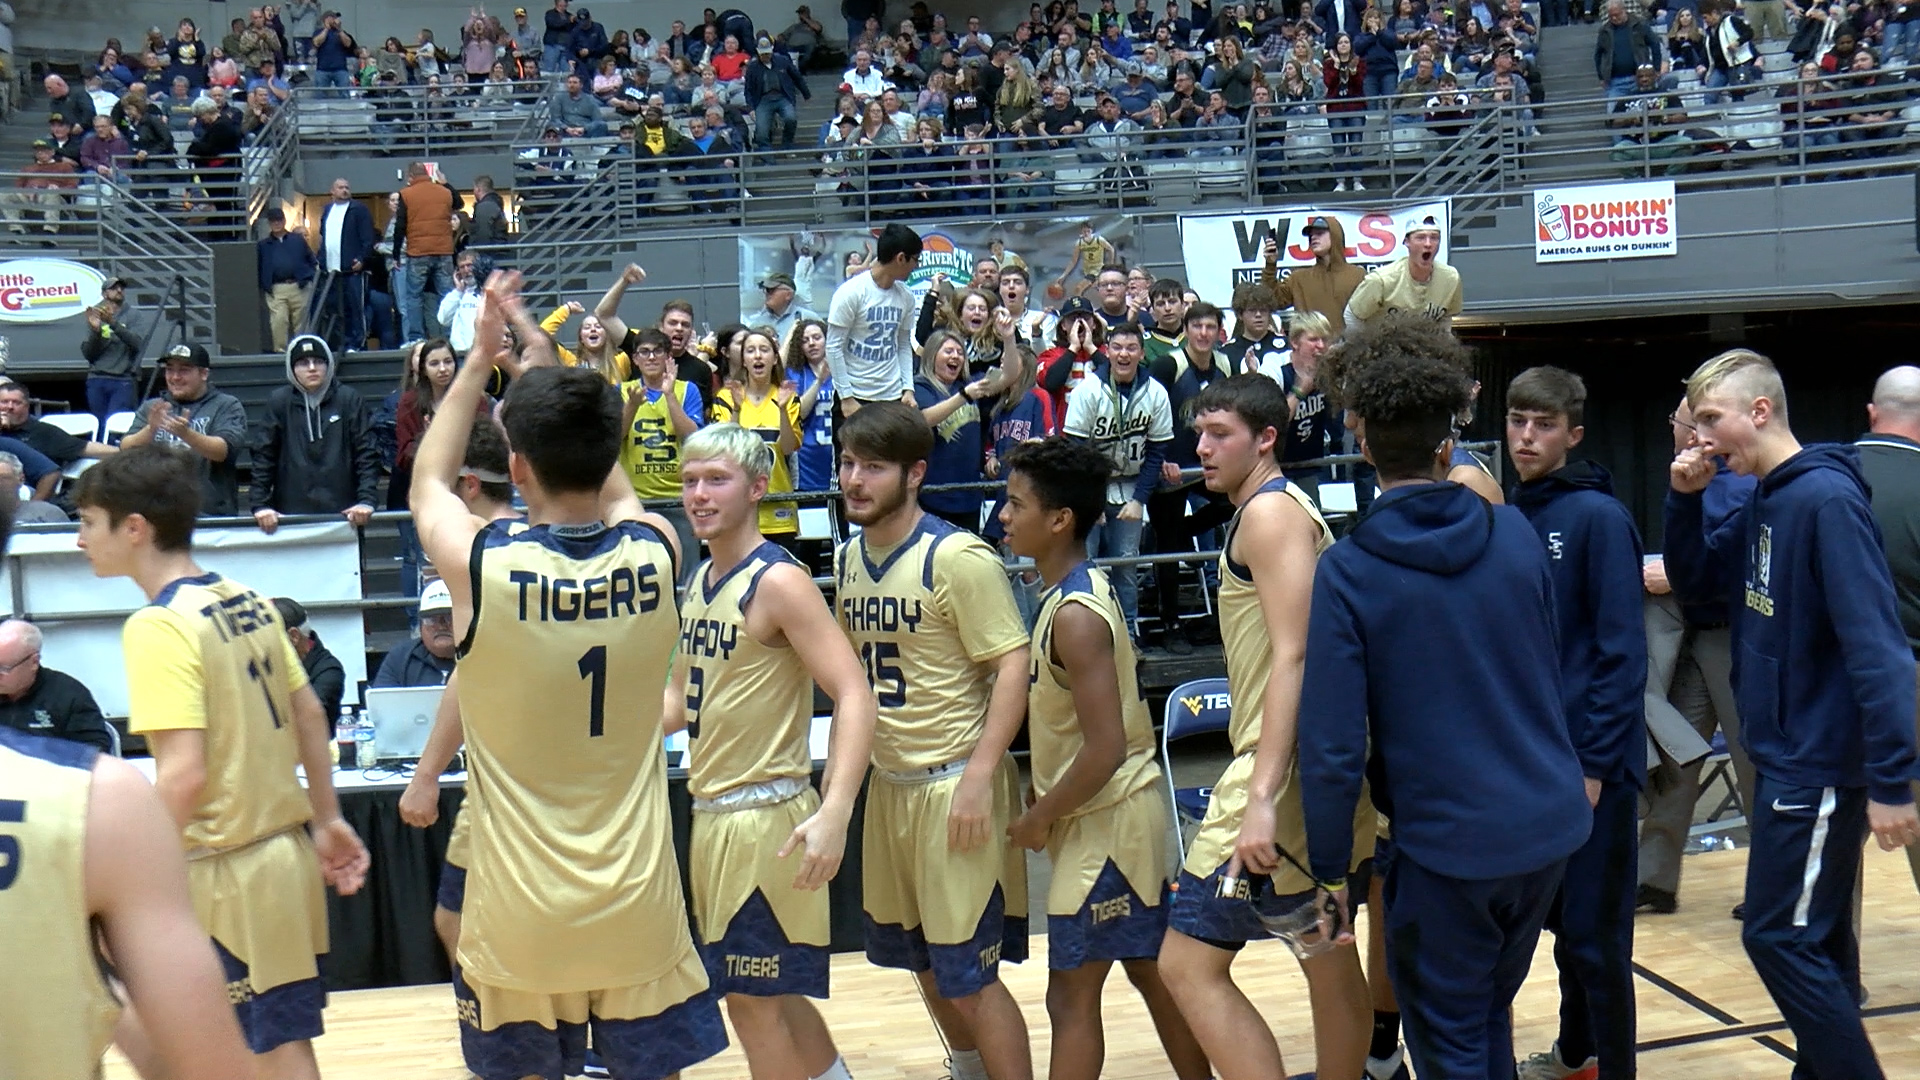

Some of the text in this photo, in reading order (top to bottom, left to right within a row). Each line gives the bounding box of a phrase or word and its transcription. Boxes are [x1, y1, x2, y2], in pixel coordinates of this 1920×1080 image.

[1573, 198, 1673, 221] DUNKIN'
[1232, 212, 1397, 263] WJS
[1574, 217, 1668, 240] DONUTS
[1540, 241, 1673, 256] AMERICA RUNS ON DUNKIN'
[0, 273, 35, 287] ittle
[1, 282, 79, 311] General
[635, 463, 678, 475] DEFENSE
[509, 562, 661, 622] TIGERS
[680, 617, 738, 661] HADY
[861, 641, 907, 708] 15
[577, 644, 608, 738] 1
[1090, 893, 1132, 925] TIGERS
[725, 954, 780, 979] TIGERS
